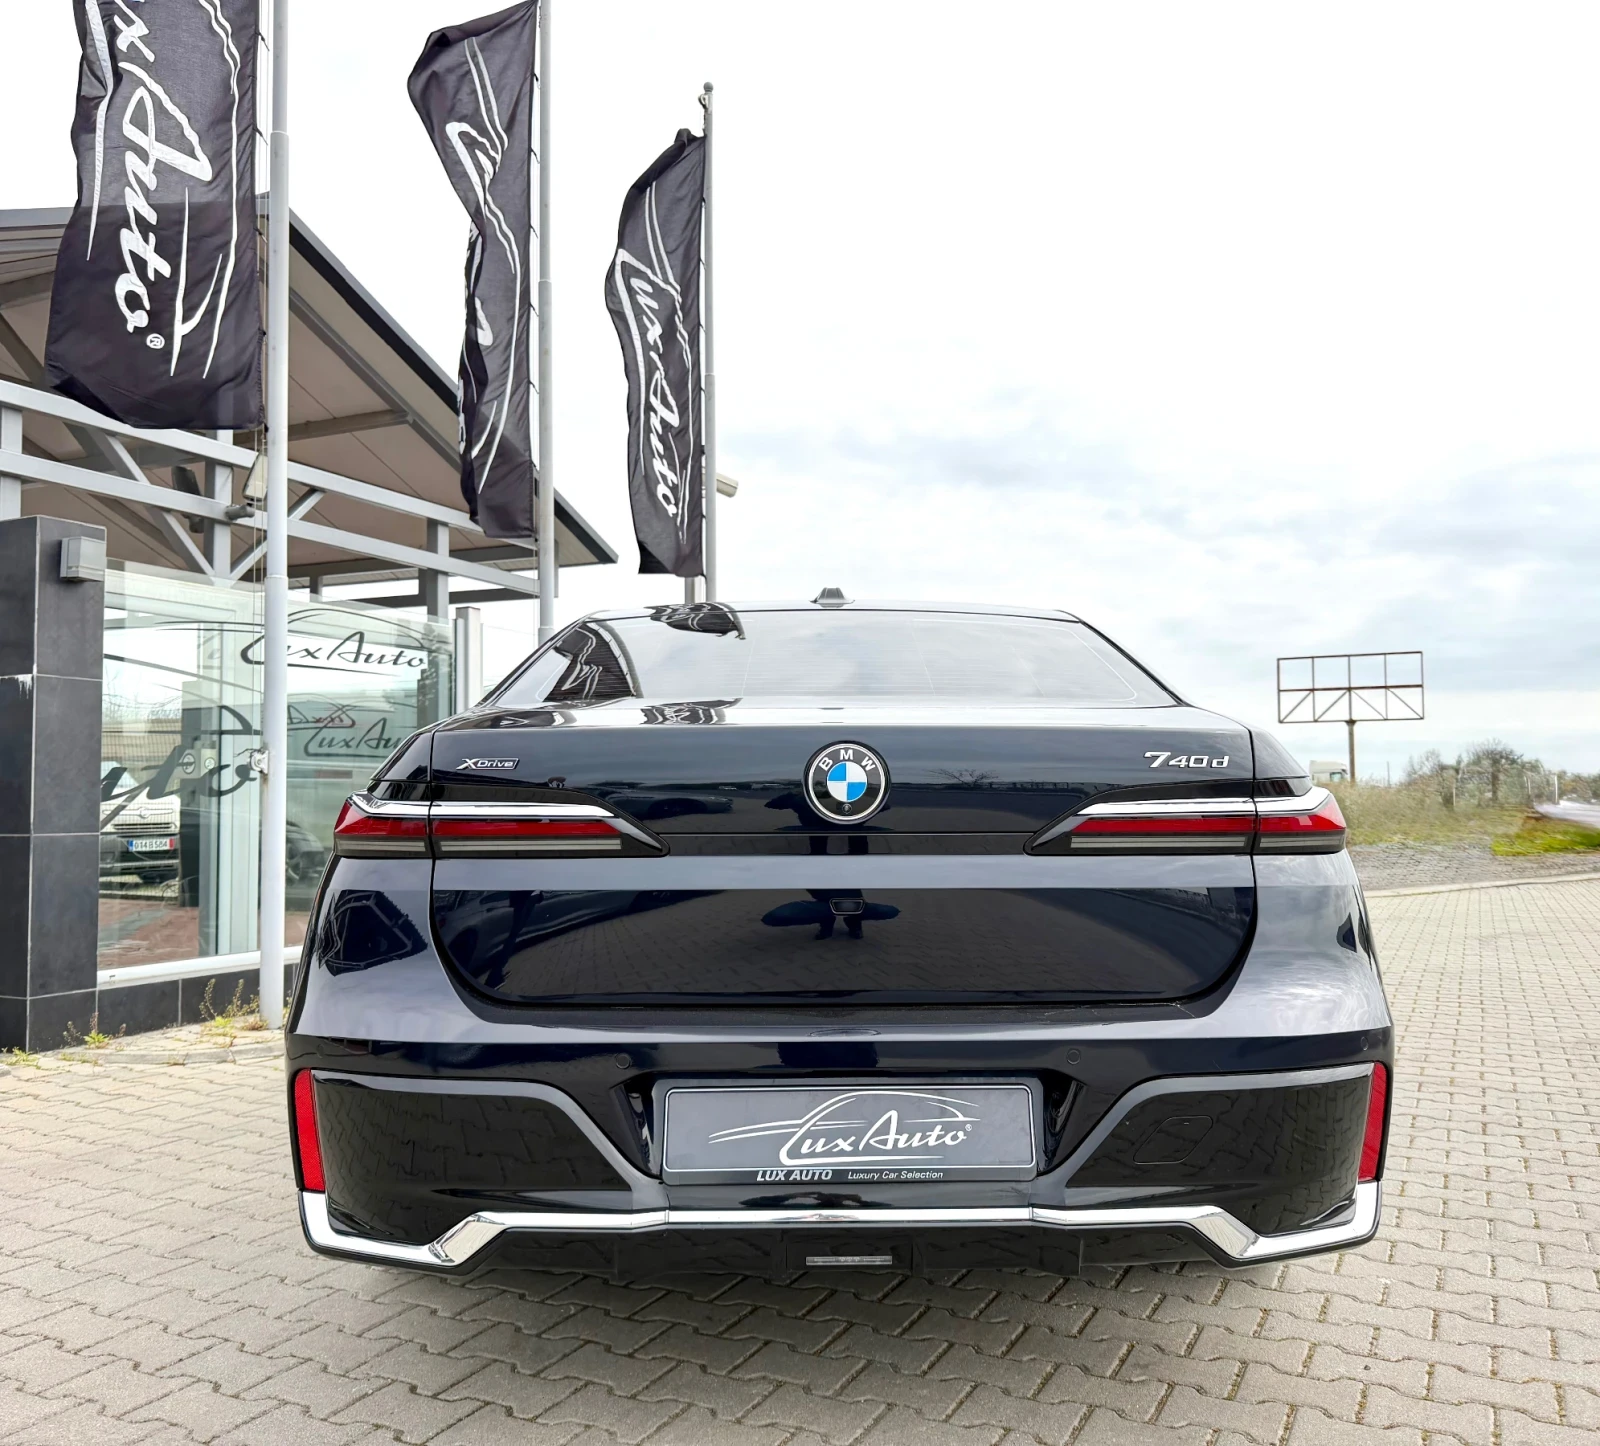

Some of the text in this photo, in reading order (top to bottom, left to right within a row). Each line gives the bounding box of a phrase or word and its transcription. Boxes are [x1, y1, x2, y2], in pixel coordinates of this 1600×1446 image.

[818, 748, 876, 771] BMW
[756, 1169, 944, 1182] LUX AUTO Luxury Car Selection
